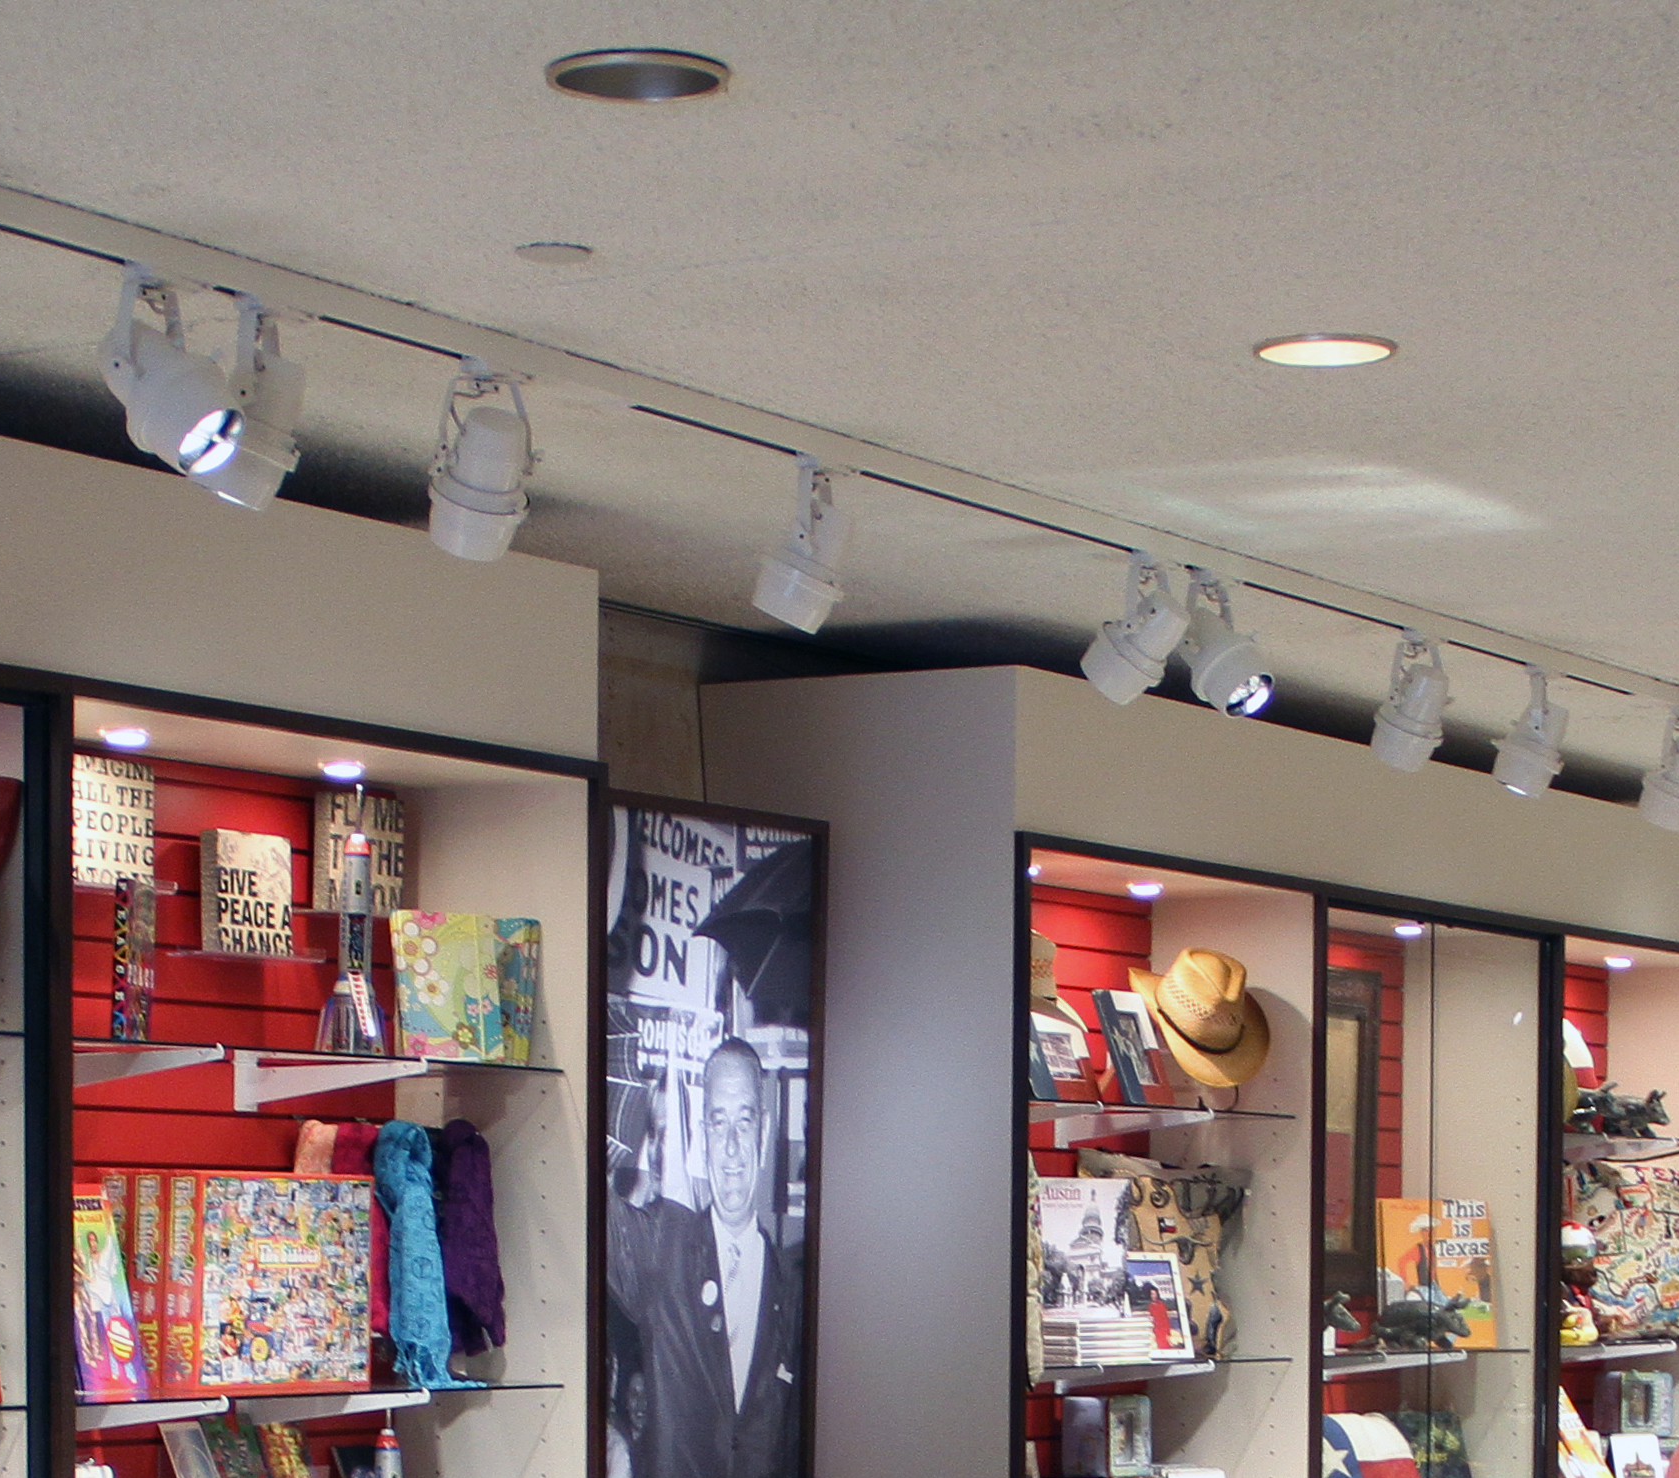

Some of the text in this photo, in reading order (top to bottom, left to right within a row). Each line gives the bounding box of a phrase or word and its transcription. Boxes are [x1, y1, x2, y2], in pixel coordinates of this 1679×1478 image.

[72, 779, 111, 803] ALL
[72, 807, 154, 838] PEOPLE
[72, 836, 154, 866] LIVING
[219, 866, 259, 898] GIVE
[218, 897, 276, 930] PEACE
[636, 923, 688, 987] ON
[1041, 1184, 1082, 1201] Austin
[1442, 1198, 1486, 1218] This
[1454, 1220, 1471, 1237] is
[1437, 1239, 1490, 1257] Texas
